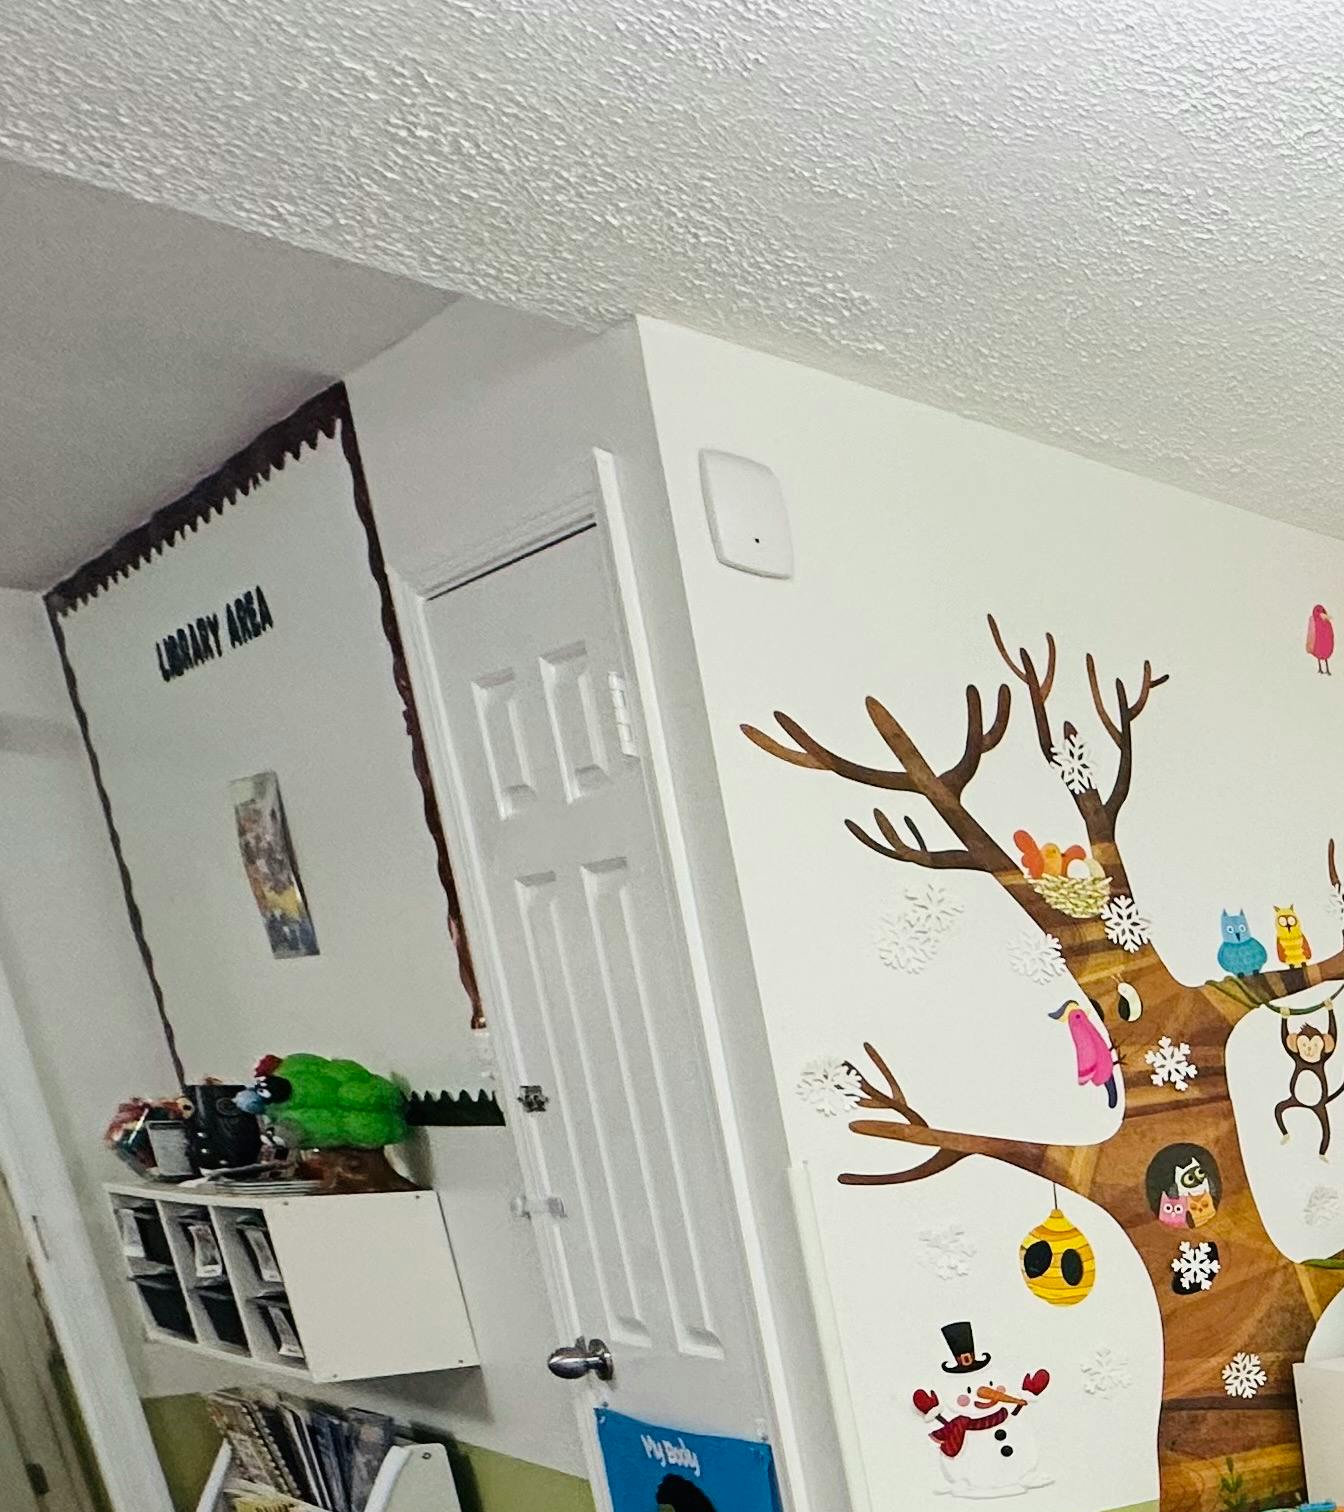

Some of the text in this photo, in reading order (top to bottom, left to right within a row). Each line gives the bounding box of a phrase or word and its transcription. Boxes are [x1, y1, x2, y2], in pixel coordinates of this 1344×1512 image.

[156, 584, 273, 682] LIBRARY AREA
[640, 1434, 700, 1477] My Body
